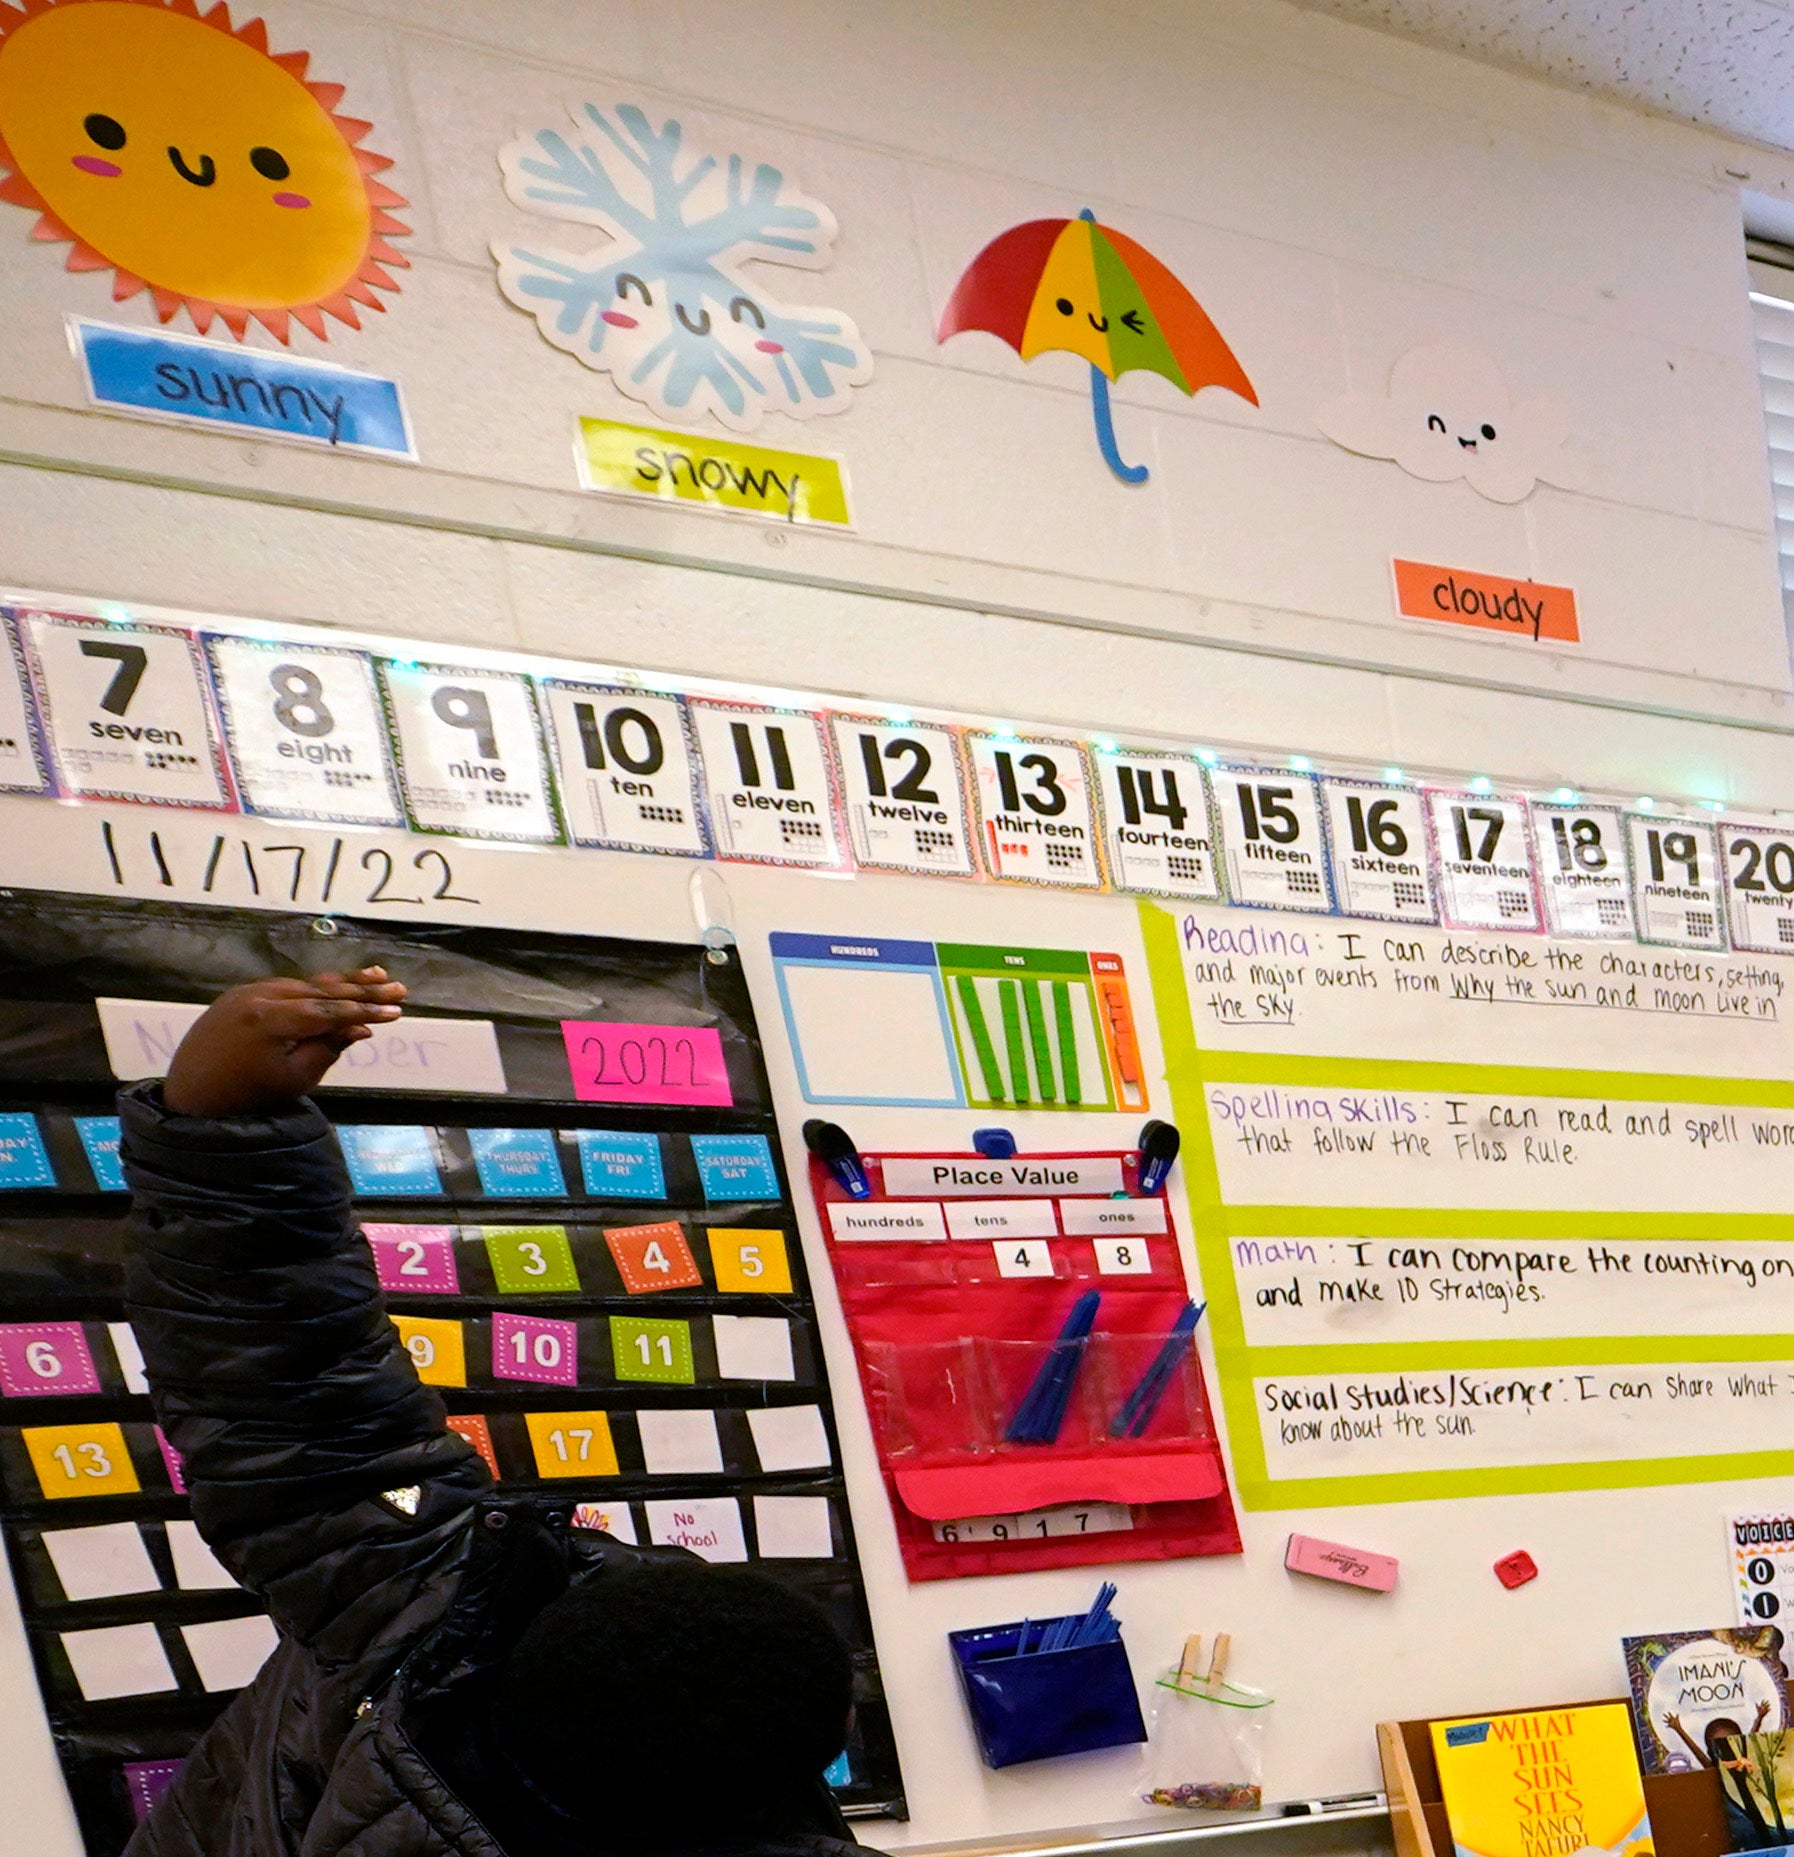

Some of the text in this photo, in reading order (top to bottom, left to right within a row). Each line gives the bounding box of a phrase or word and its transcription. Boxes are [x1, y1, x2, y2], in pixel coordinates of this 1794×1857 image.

[156, 362, 343, 445] sunny
[636, 443, 800, 522] snowy
[1433, 576, 1543, 641] cloudy
[79, 640, 148, 717] 7
[270, 664, 335, 736] 8
[90, 718, 184, 746] seven
[430, 685, 498, 759] 9
[277, 737, 353, 767] eight
[574, 703, 663, 776] 10
[449, 757, 506, 782] nine
[730, 722, 795, 790] 11
[859, 734, 940, 803] 12
[610, 777, 654, 798] ten
[994, 751, 1059, 816] 13
[1115, 765, 1188, 830] 14
[733, 791, 815, 814] eleven
[869, 801, 949, 825] twelve
[1236, 782, 1301, 844] 15
[995, 815, 1084, 840] thirteen
[1118, 826, 1209, 852] fourteen
[1345, 796, 1409, 857] 16
[1448, 806, 1505, 862] 17
[1244, 841, 1312, 866] fifteen
[1549, 817, 1609, 871] 18
[1645, 829, 1700, 887] 19
[102, 821, 481, 905] 11/17/22
[1350, 854, 1421, 877] sixteen
[1444, 859, 1529, 880] seventeen
[1552, 873, 1621, 889] eighteen
[1643, 883, 1710, 902] nineteen
[1744, 891, 1794, 910] twenty
[1337, 934, 1366, 960] I
[1384, 940, 1424, 962] can
[1442, 939, 1538, 968] describe
[1545, 947, 1583, 970] the
[1600, 953, 1722, 989] characters,
[1196, 960, 1704, 1012] and major events from Why the sun and moon
[580, 1036, 711, 1088] 2022
[1445, 1101, 1468, 1125] I
[1489, 1106, 1538, 1128] can
[1558, 1104, 1612, 1134] read
[1625, 1108, 1672, 1136] and
[1686, 1115, 1738, 1148] spell
[593, 1152, 643, 1164] FRIDAY
[1237, 1126, 1292, 1155] that
[1314, 1126, 1374, 1155] follow
[1390, 1131, 1430, 1156] the
[1454, 1131, 1507, 1160] Floss
[606, 1164, 630, 1175] FRI
[705, 1155, 761, 1168] SATURDAY
[933, 1166, 1080, 1185] Place Value
[846, 1215, 924, 1228] hundreds
[974, 1214, 1008, 1227] tens
[1098, 1211, 1135, 1223] ones
[398, 1240, 428, 1274] 2
[522, 1242, 547, 1276] 3
[643, 1240, 669, 1274] 4
[740, 1248, 764, 1277] 5
[1014, 1248, 1030, 1268] 4
[1117, 1247, 1131, 1266] 8
[1347, 1242, 1794, 1288] I can compare the counting on
[1256, 1276, 1419, 1308] and make 10
[25, 1340, 62, 1380] 6
[509, 1332, 561, 1366] 10
[634, 1335, 674, 1366] 11
[1265, 1378, 1653, 1412] Social can
[1280, 1409, 1426, 1445] know about the
[53, 1443, 113, 1478] 13
[548, 1430, 595, 1463] 17
[674, 1512, 694, 1527] No
[1736, 1522, 1794, 1545] VOICE
[667, 1530, 718, 1547] school
[1679, 1660, 1746, 1681] IMANI'S
[1679, 1682, 1744, 1704] MOON
[1490, 1713, 1575, 1742] WHAT
[1511, 1740, 1567, 1766] THE
[1514, 1764, 1573, 1791] SUN
[1514, 1789, 1583, 1817] SEES
[1519, 1815, 1584, 1838] NANCY
